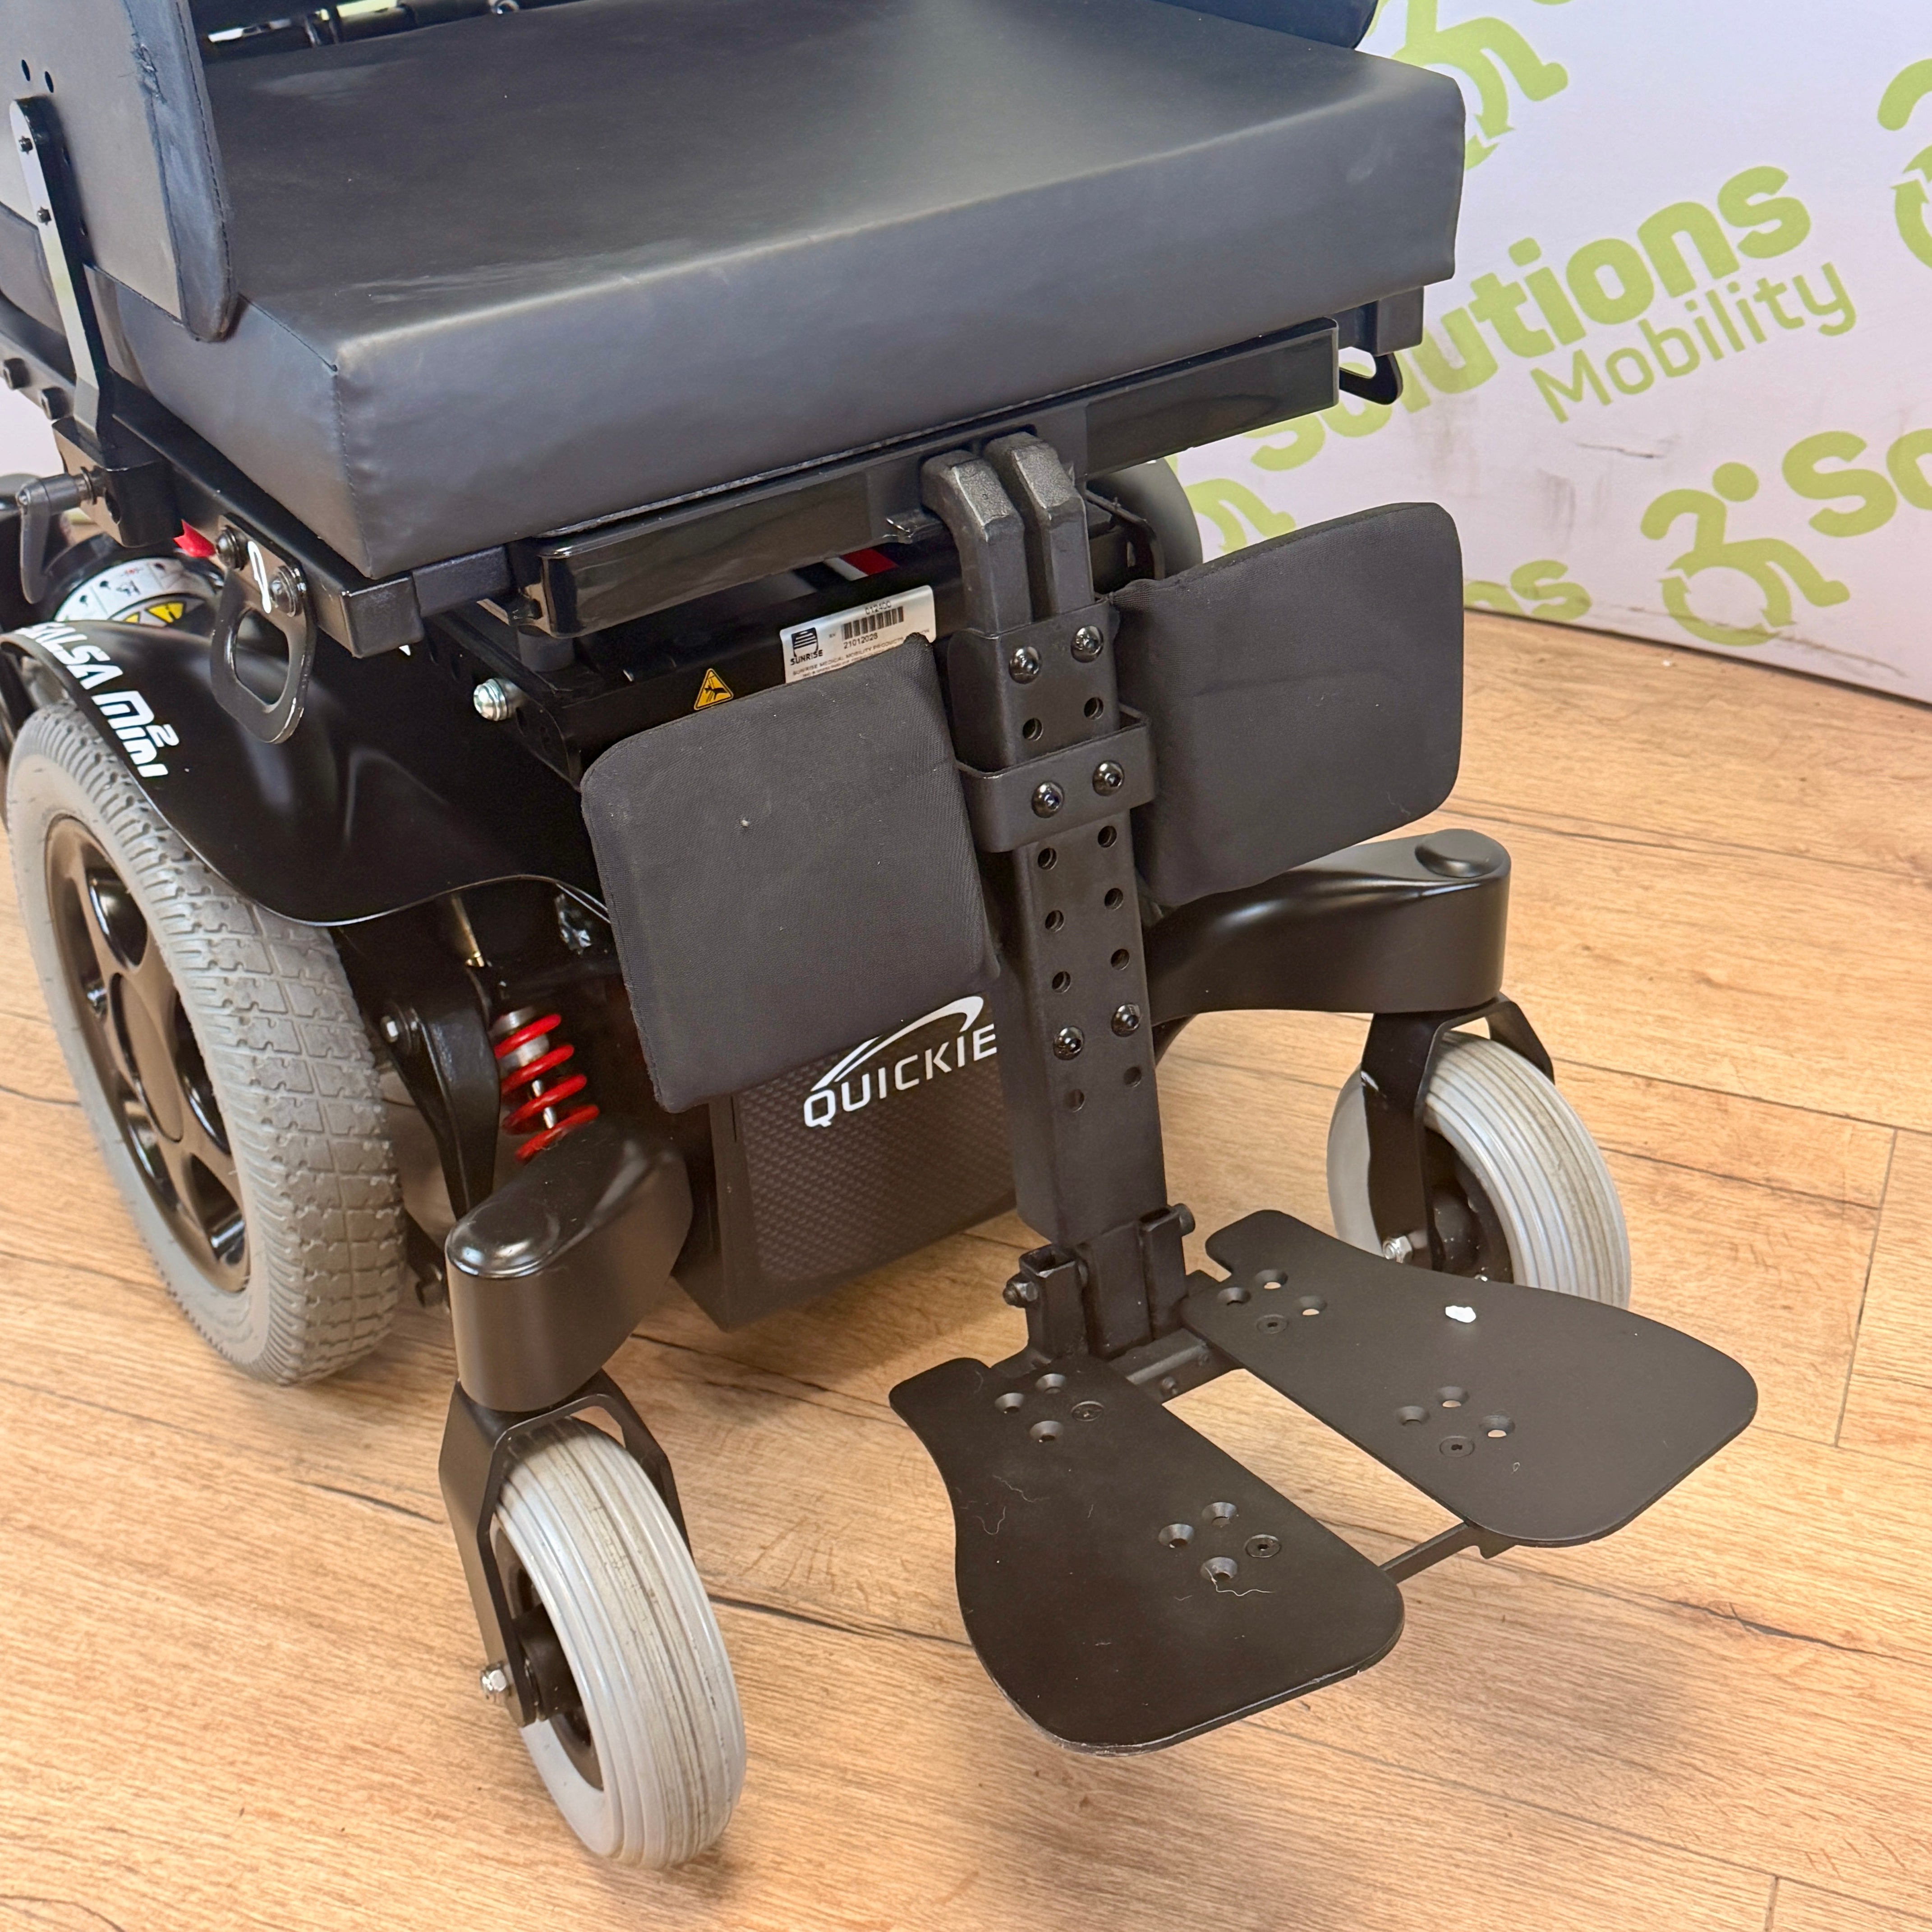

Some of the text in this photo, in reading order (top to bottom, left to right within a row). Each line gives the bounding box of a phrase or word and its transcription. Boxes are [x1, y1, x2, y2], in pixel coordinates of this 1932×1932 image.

[1530, 262, 1856, 423] Mobility
[790, 649, 823, 666] SUNRISE
[793, 664, 818, 676] SUNRISE
[819, 656, 844, 667] MEDICAL
[846, 647, 872, 658] MOBILITY
[804, 1024, 997, 1127] QUICKIE
